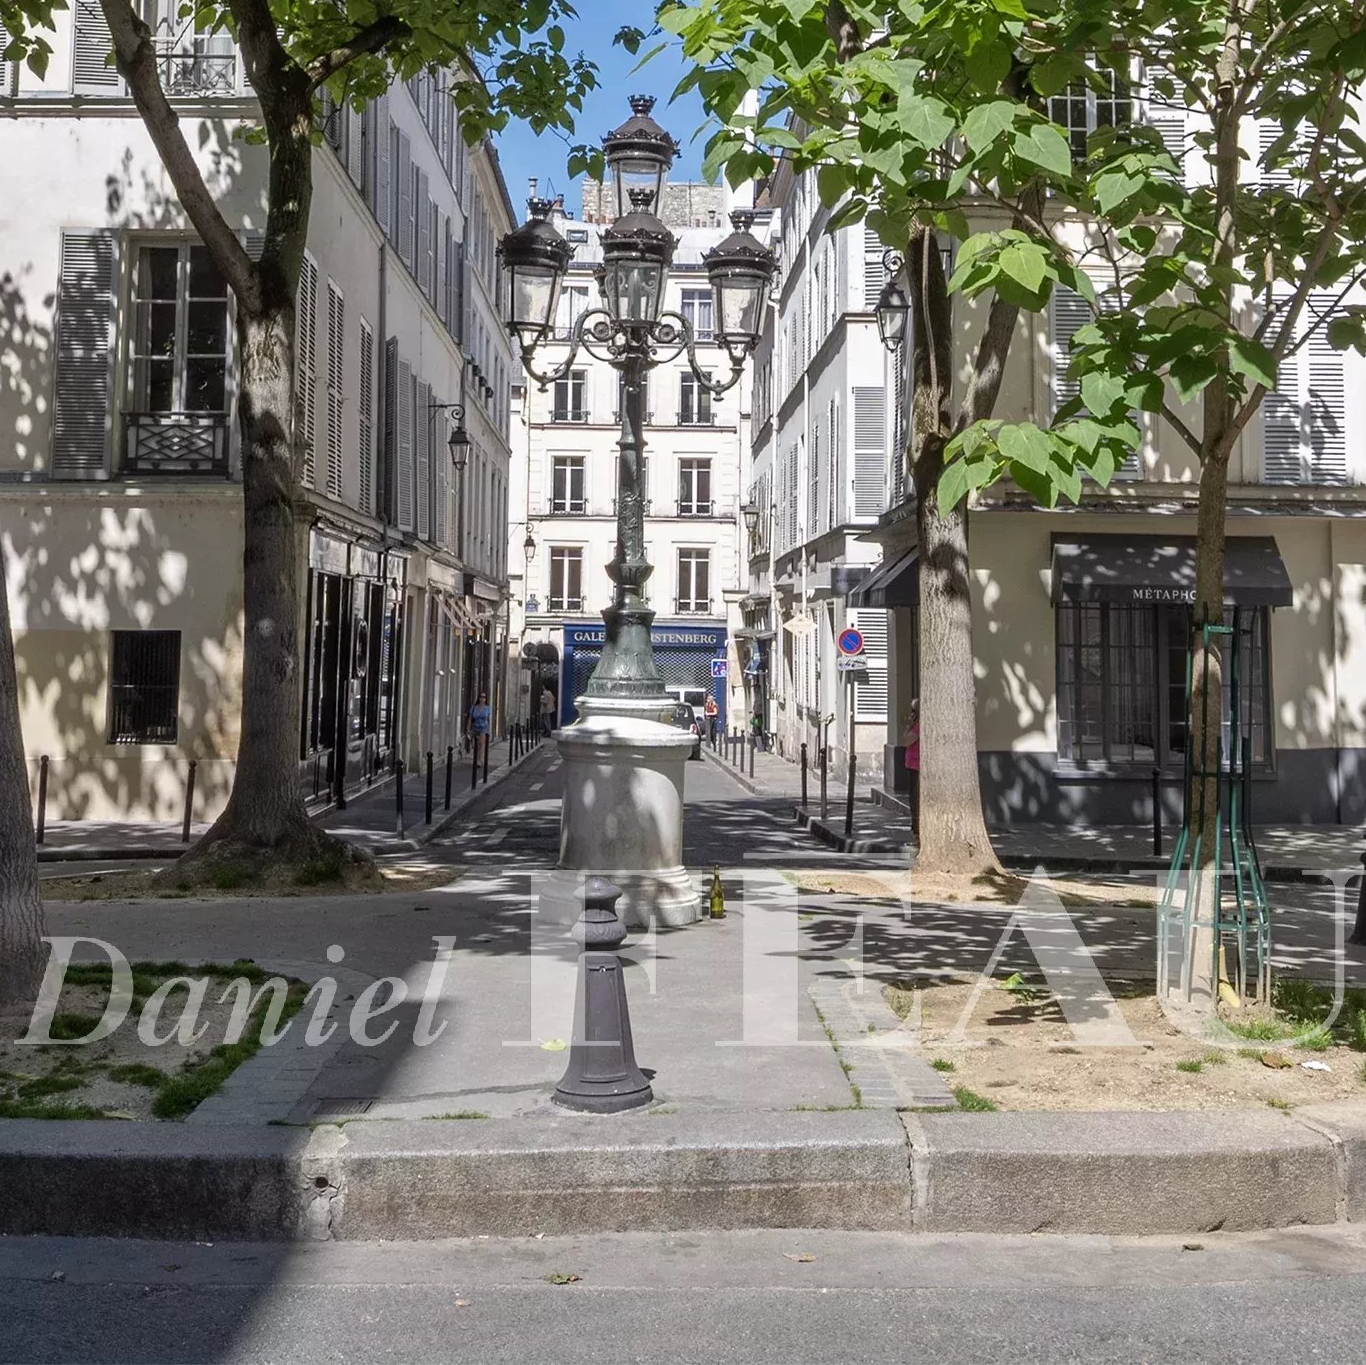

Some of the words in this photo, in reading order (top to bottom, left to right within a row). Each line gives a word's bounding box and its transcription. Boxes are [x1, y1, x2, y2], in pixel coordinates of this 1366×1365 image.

[1132, 587, 1197, 600] MÉTAPHO
[574, 631, 605, 643] GALE
[651, 633, 717, 644] RSTENBERG
